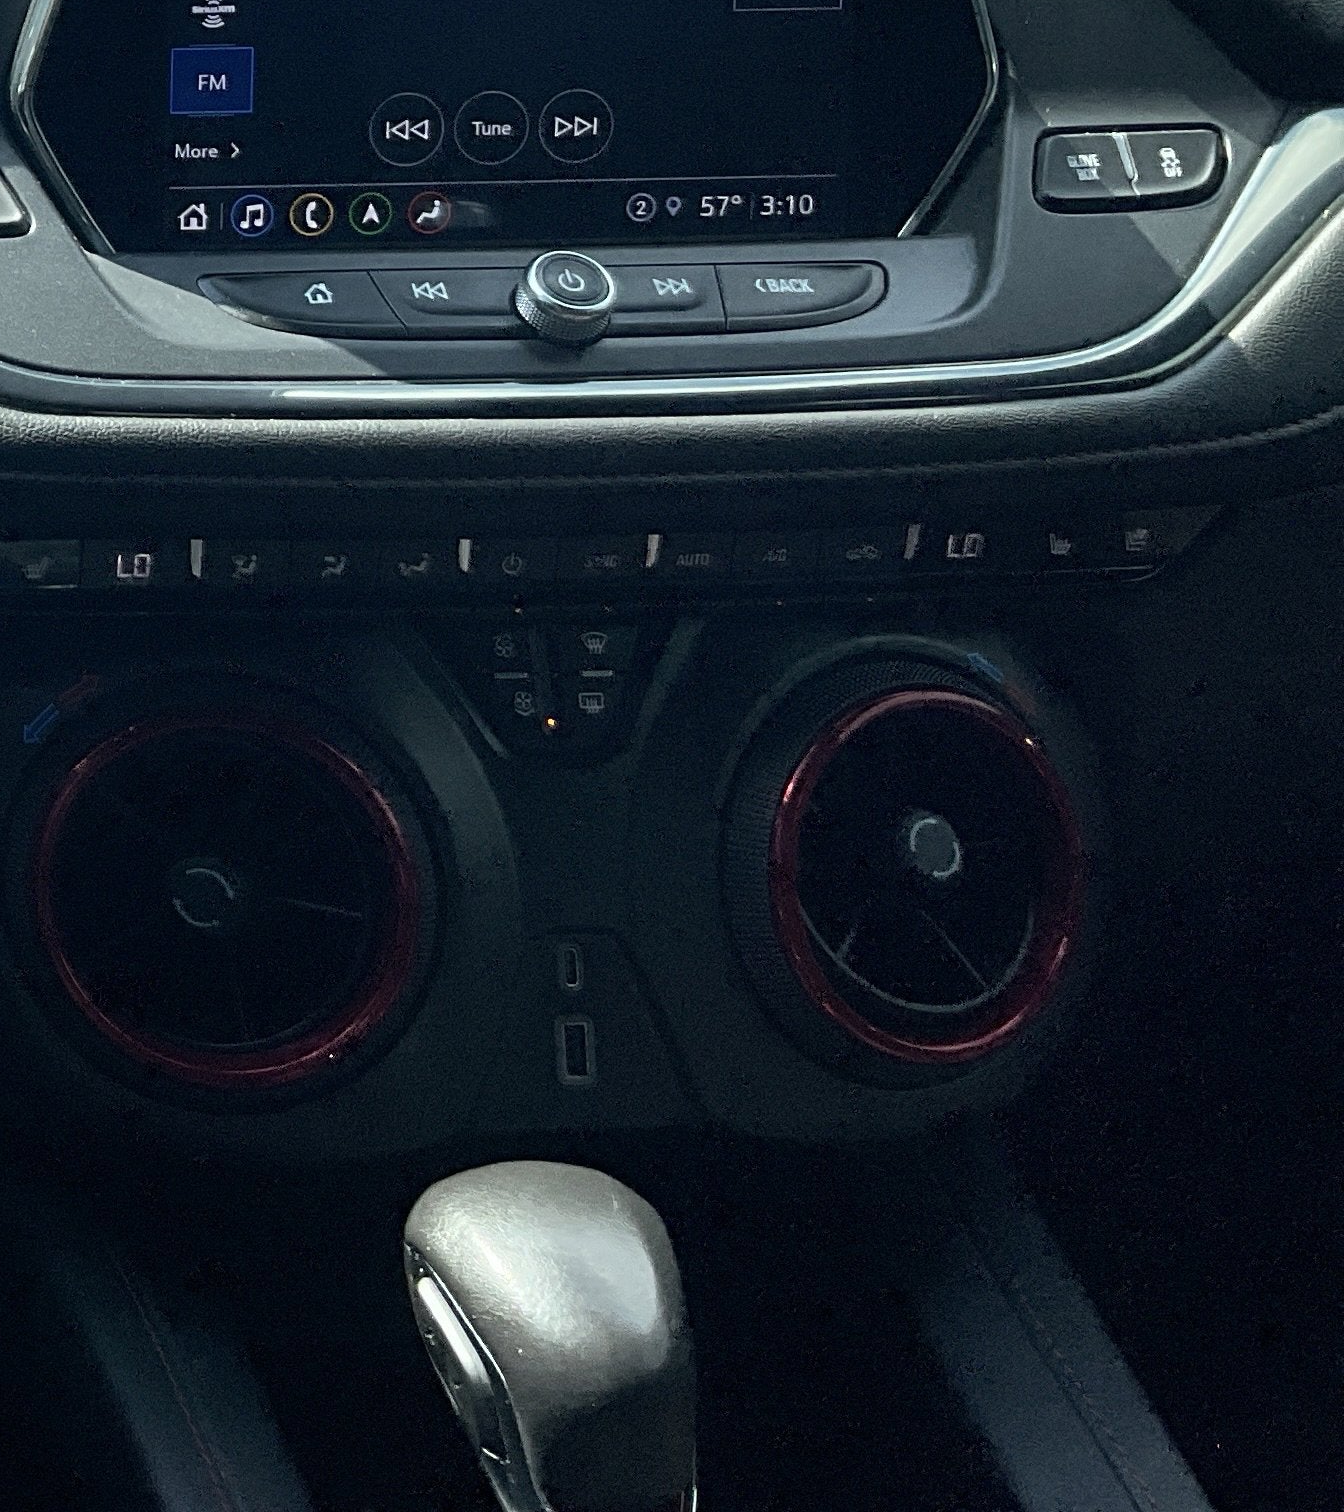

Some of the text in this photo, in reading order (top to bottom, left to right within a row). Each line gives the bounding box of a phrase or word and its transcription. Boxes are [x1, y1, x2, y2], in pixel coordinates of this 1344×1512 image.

[198, 74, 227, 91] FM
[471, 120, 512, 136] Tune
[174, 143, 219, 159] More
[635, 200, 647, 216] 2
[699, 194, 743, 217] 57°
[760, 194, 814, 216] 3:10
[764, 278, 815, 293] BACK
[675, 552, 711, 567] AUTO
